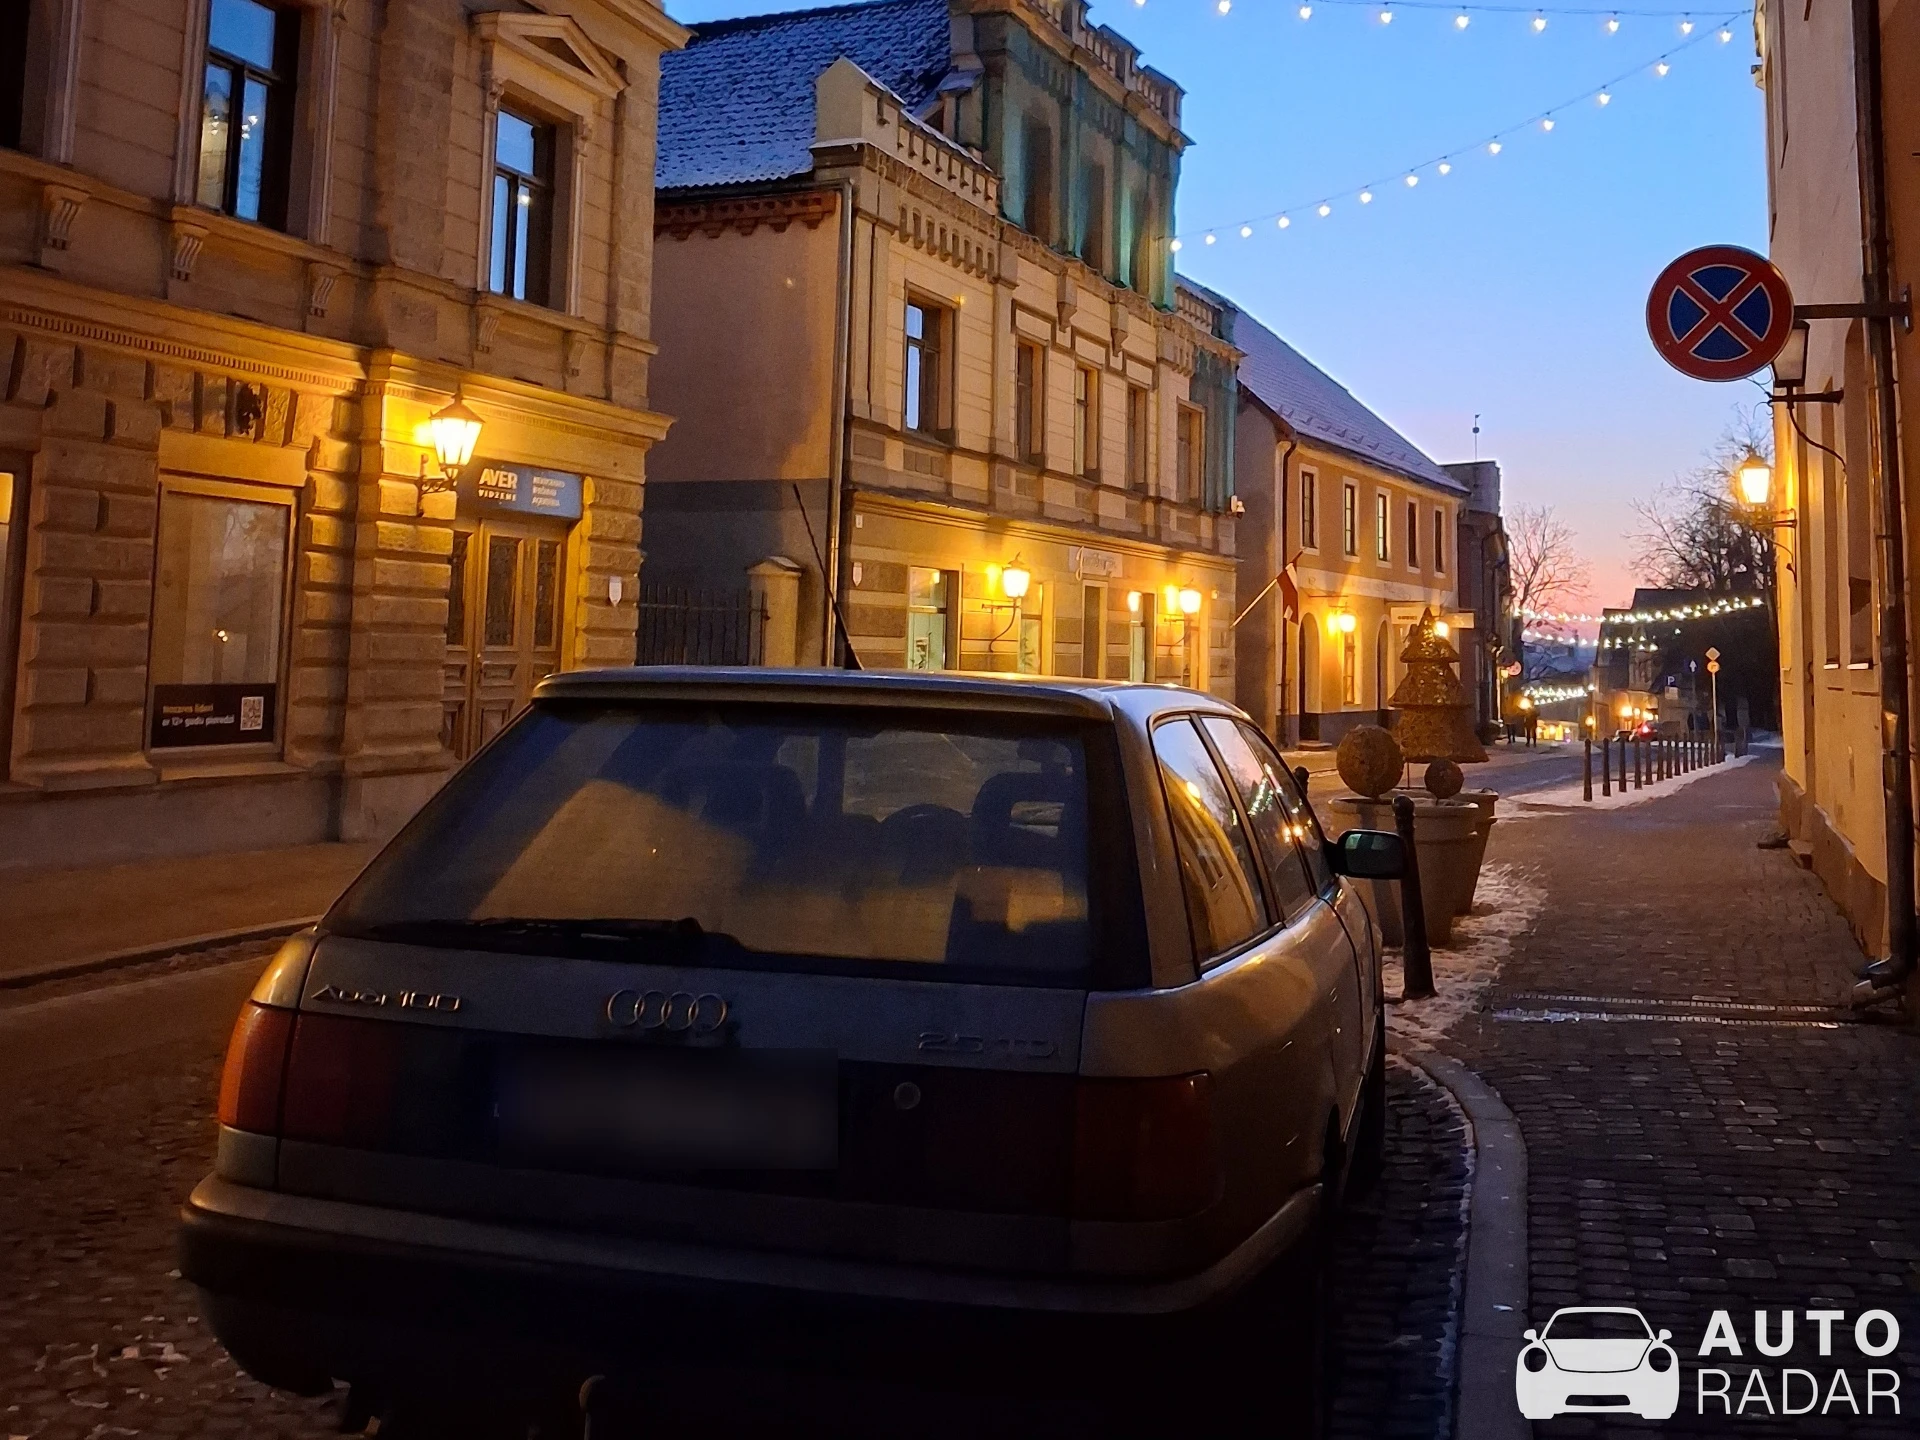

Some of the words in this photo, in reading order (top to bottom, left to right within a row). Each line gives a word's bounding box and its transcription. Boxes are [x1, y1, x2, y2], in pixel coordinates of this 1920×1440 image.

[478, 468, 518, 490] AVER
[478, 489, 517, 501] VIDZEME
[1667, 676, 1675, 686] P
[400, 989, 461, 1012] 100
